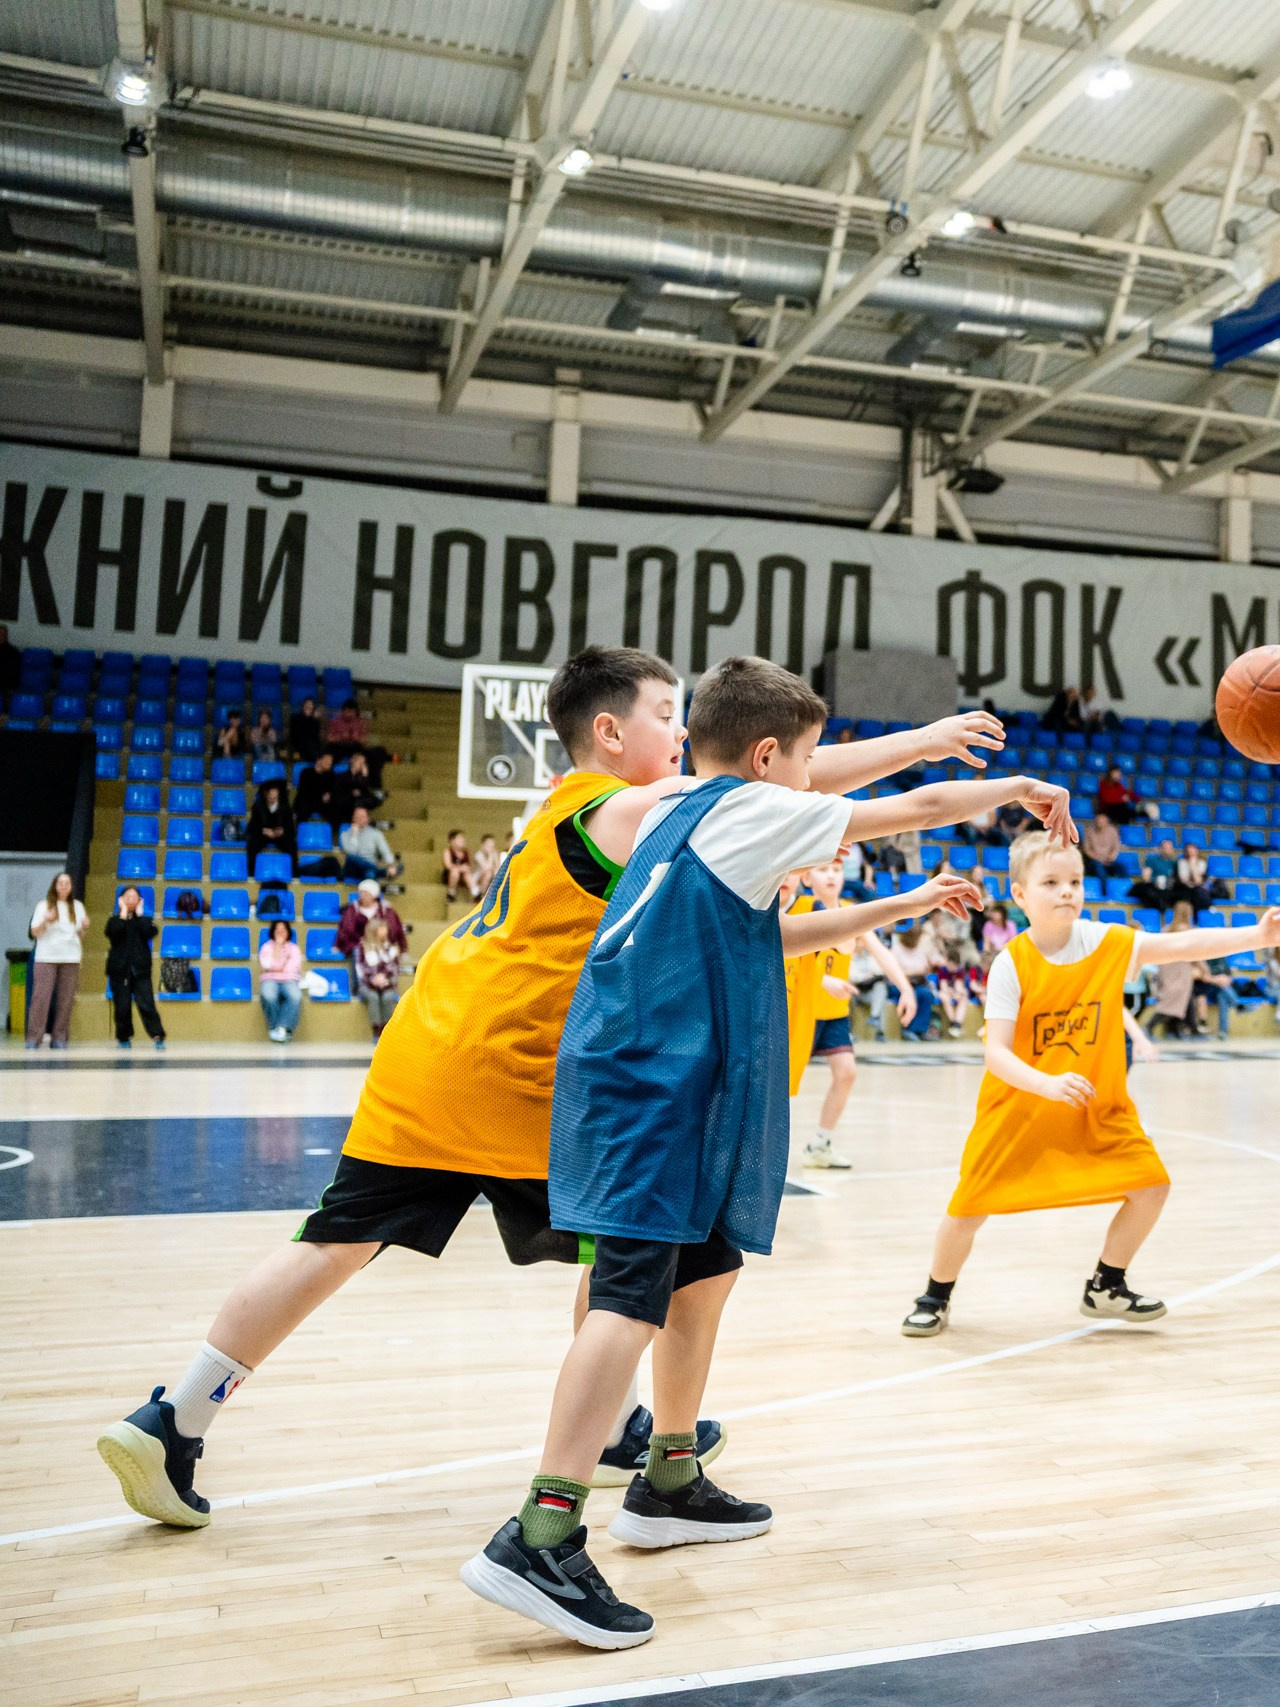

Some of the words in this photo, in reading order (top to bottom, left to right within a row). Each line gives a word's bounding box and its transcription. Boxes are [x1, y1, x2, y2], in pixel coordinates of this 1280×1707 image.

[351, 518, 871, 680] НОВГОРОД
[937, 569, 1124, 700] ФОК
[485, 679, 552, 722] PLAY
